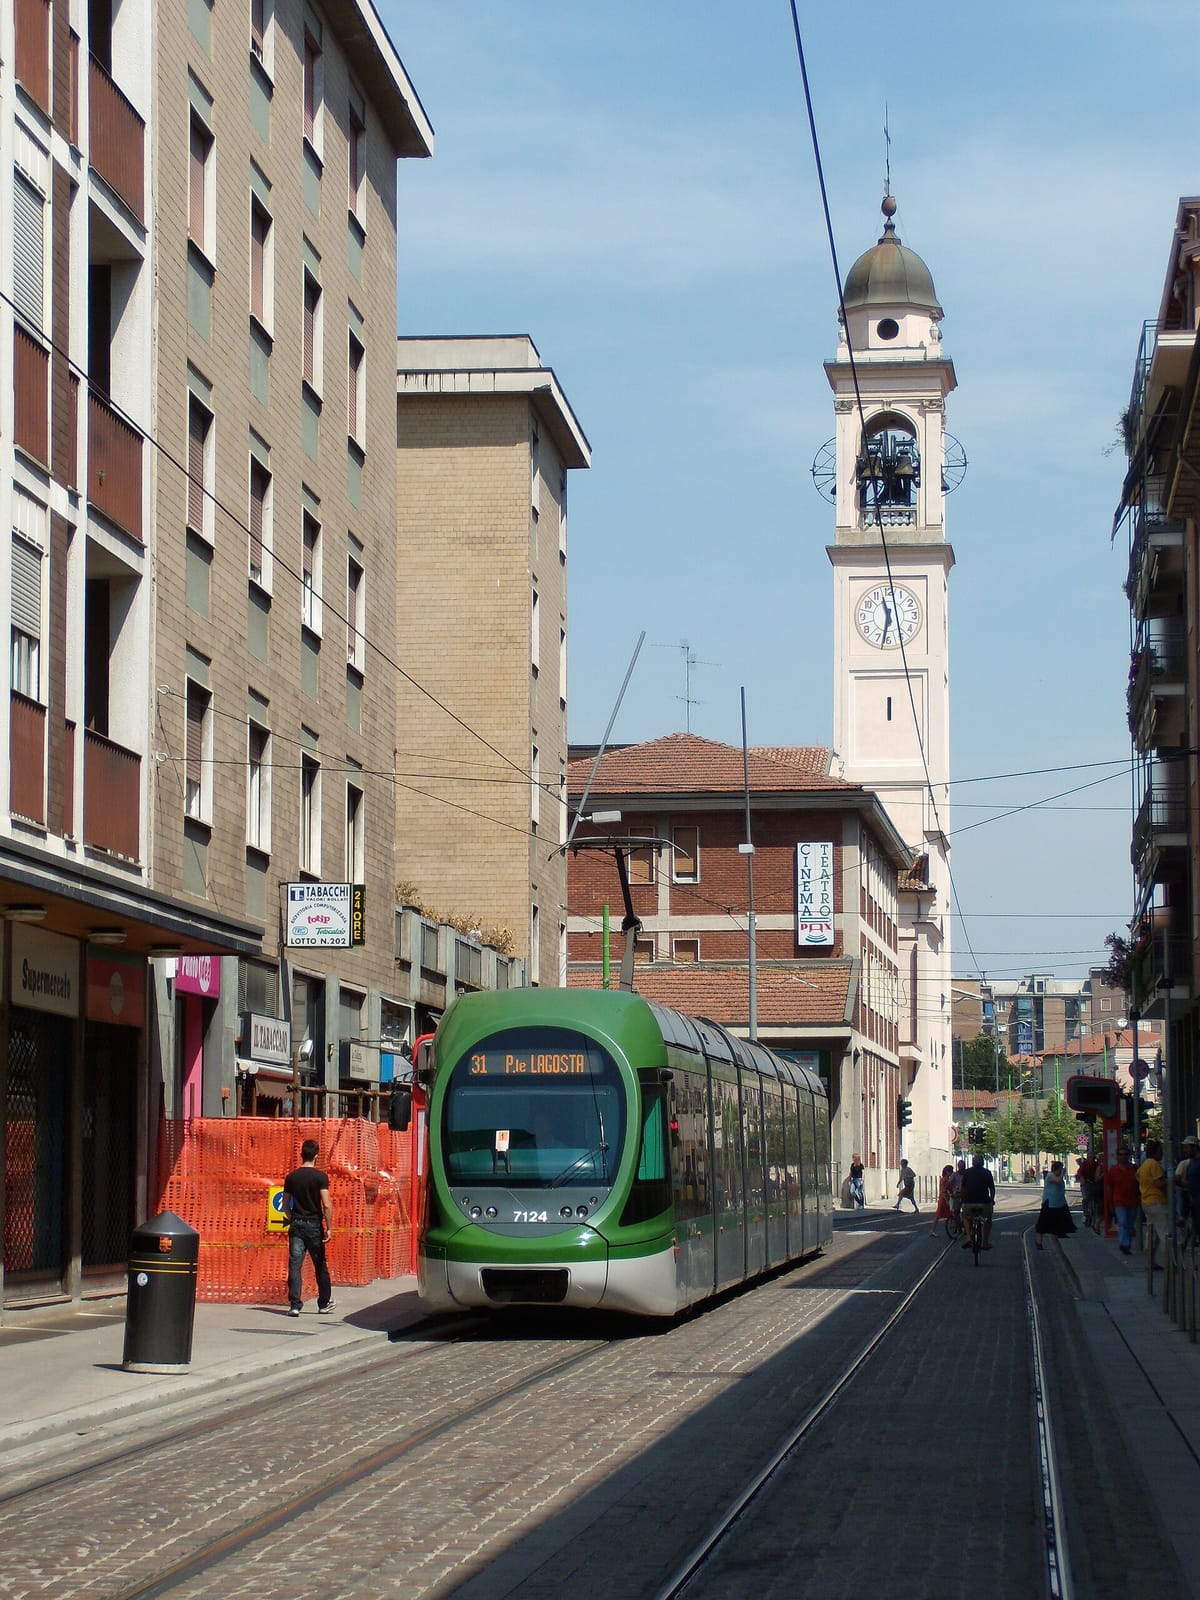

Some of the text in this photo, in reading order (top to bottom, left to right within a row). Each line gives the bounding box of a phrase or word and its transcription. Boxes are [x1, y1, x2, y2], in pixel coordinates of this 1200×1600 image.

[873, 591, 880, 600] 11
[864, 600, 872, 609] 10
[907, 598, 914, 607] 2
[859, 612, 866, 621] 9
[911, 611, 918, 620] 3
[863, 625, 870, 634] 8
[907, 623, 913, 632] 4
[875, 633, 881, 642] 7
[885, 636, 892, 645] 6
[799, 843, 814, 917] CINEMA
[820, 843, 832, 917] TEATRO
[306, 886, 349, 897] TABACCHI
[353, 890, 362, 940] 24 ORE
[290, 937, 346, 945] LOTTO N.202
[22, 958, 71, 1000] Supermercato
[471, 1054, 585, 1074] 31 P.le LAGOSTA
[513, 1210, 548, 1223] 7124
